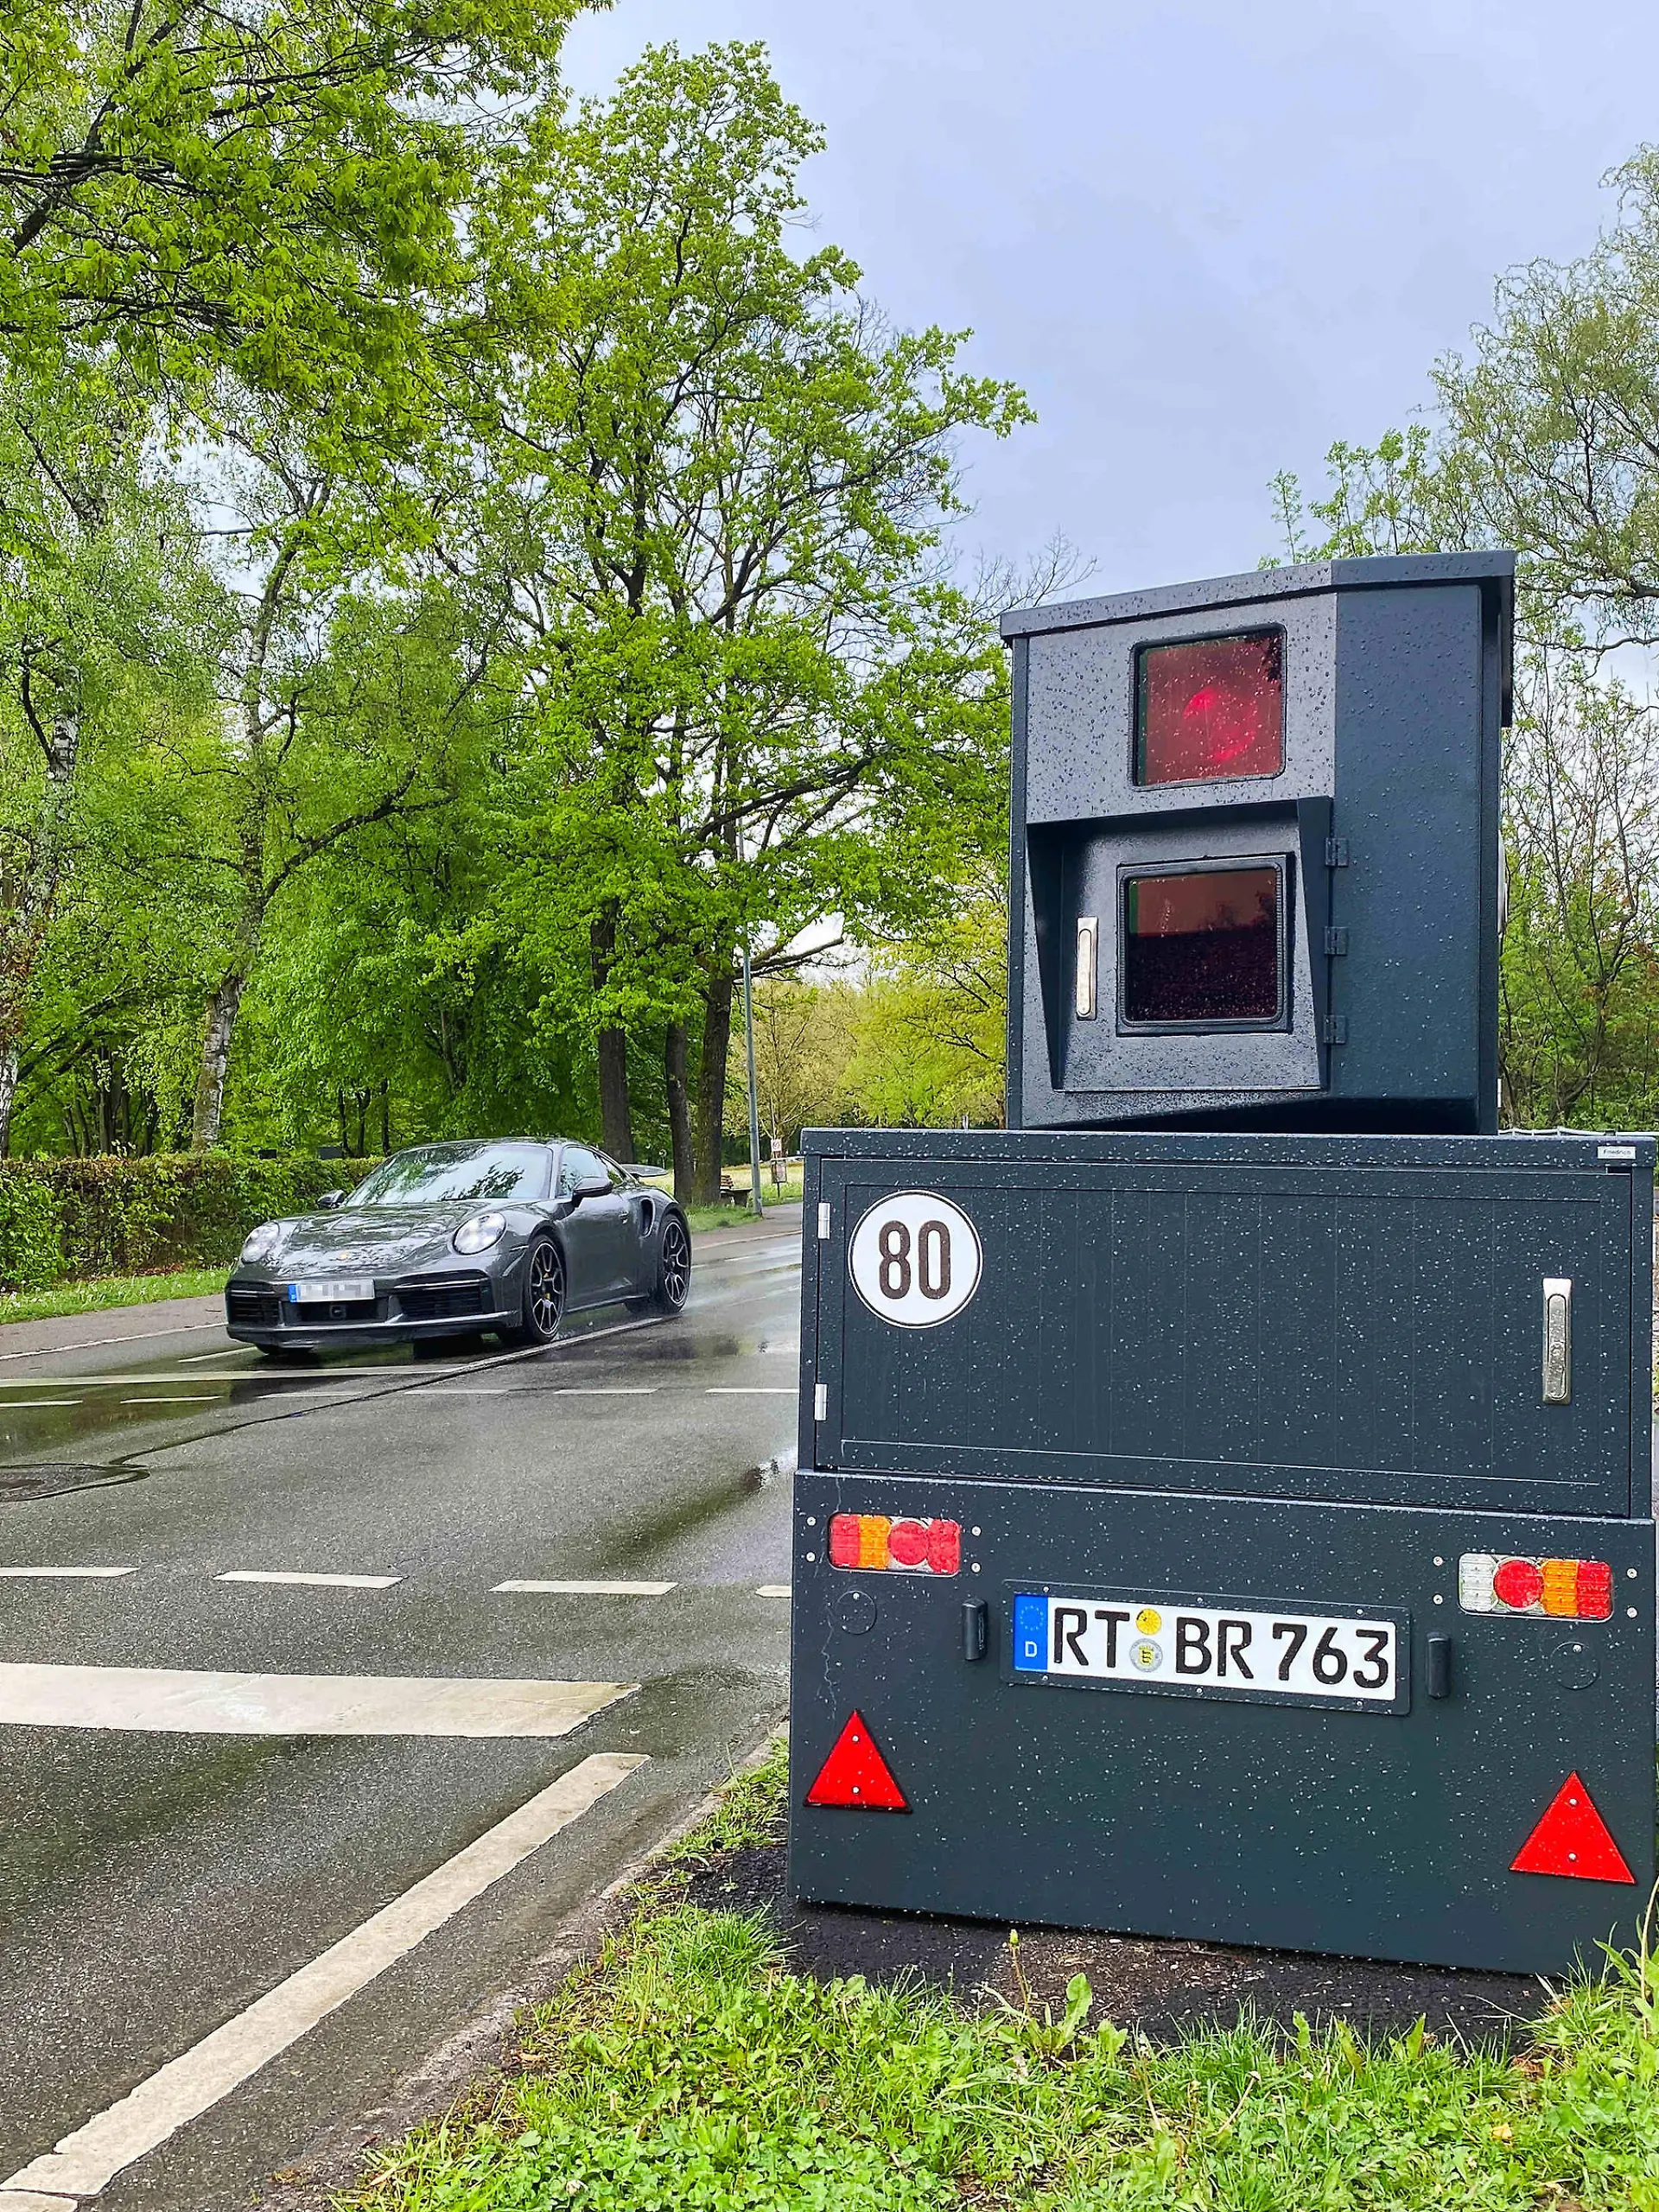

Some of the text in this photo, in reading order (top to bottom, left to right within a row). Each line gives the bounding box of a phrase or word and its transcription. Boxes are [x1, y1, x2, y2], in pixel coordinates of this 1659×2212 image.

[878, 1220, 951, 1300] 80
[1025, 1641, 1038, 1657] D
[1053, 1607, 1389, 1688] RT BR 763
